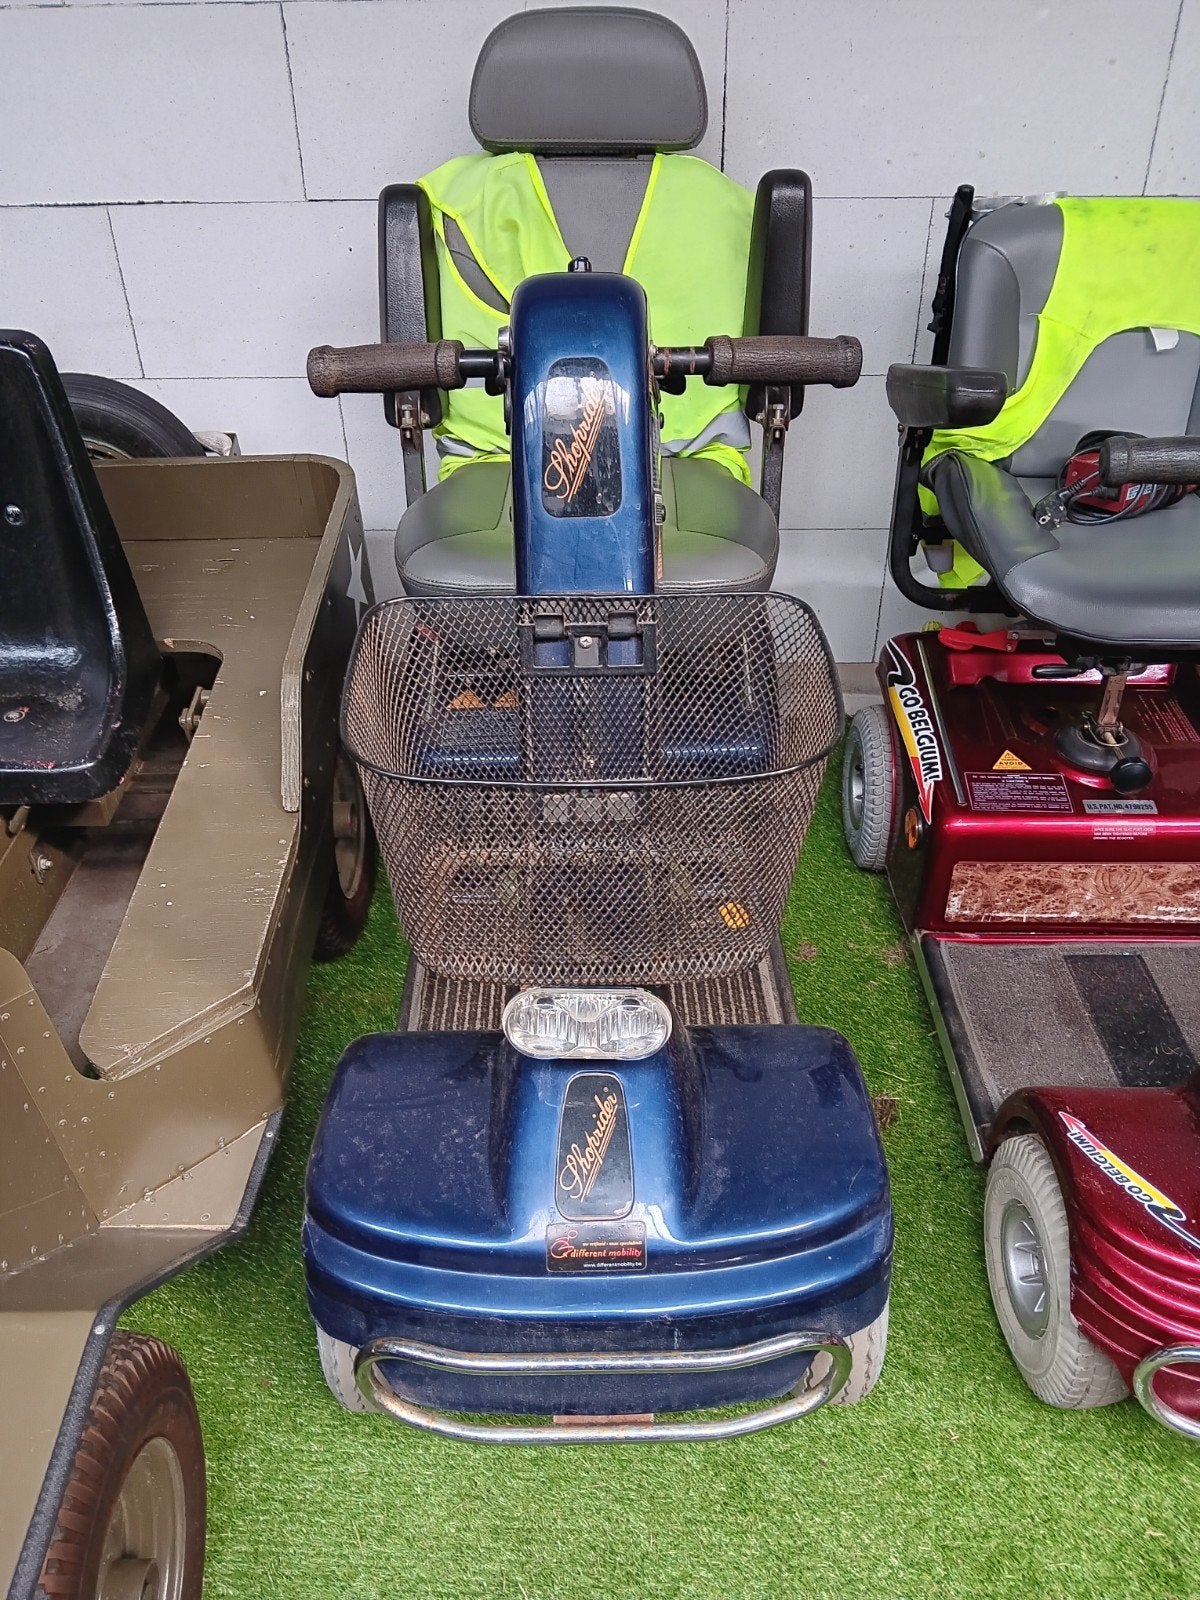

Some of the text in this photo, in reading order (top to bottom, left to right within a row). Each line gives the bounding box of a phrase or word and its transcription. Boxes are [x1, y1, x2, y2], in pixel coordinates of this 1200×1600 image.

[899, 687, 940, 783] GO BELGIUM!
[559, 1092, 618, 1200] Shoprider
[1069, 1131, 1154, 1203] GO BELGIUM!
[570, 1248, 642, 1258] different mobility
